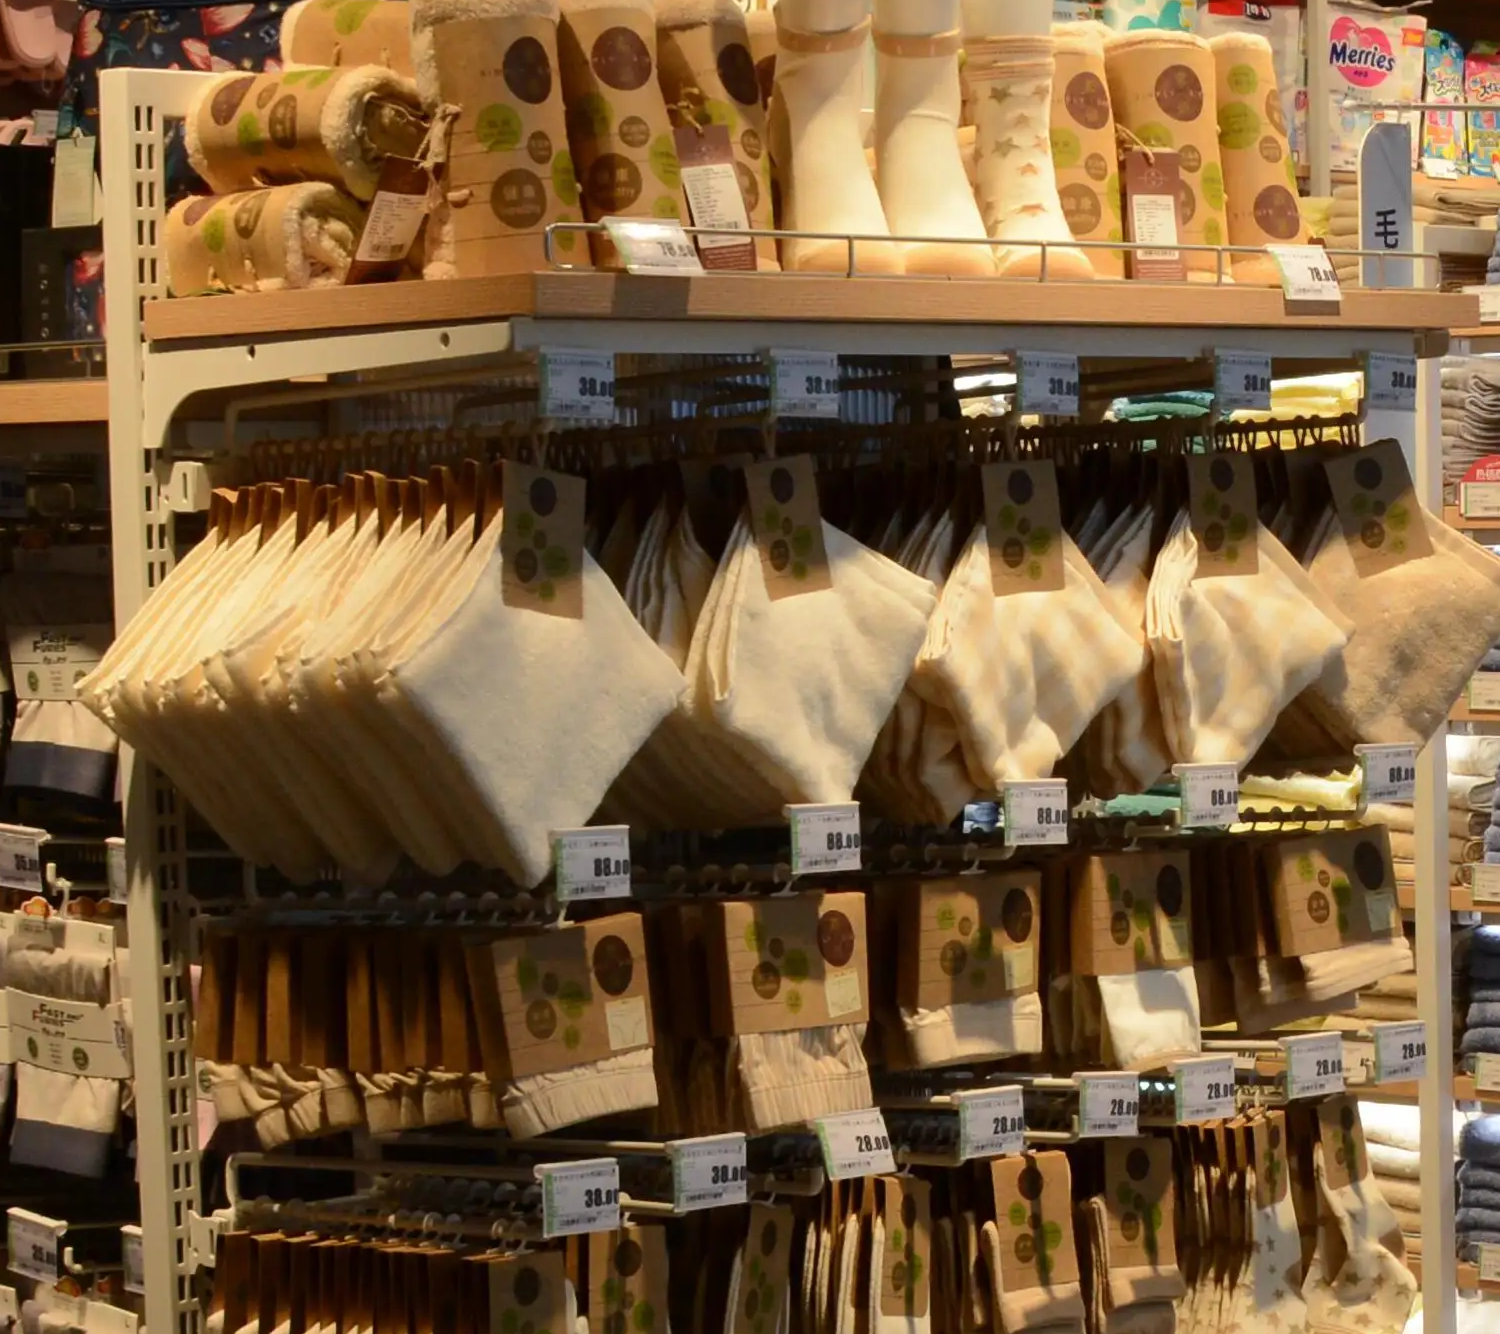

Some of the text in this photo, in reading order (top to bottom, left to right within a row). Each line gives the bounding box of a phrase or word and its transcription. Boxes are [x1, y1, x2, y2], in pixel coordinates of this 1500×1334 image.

[1328, 39, 1396, 72] Merries
[1109, 1099, 1139, 1117] 28.00
[993, 1116, 1025, 1136] 28.00
[856, 1134, 890, 1153] 28.00
